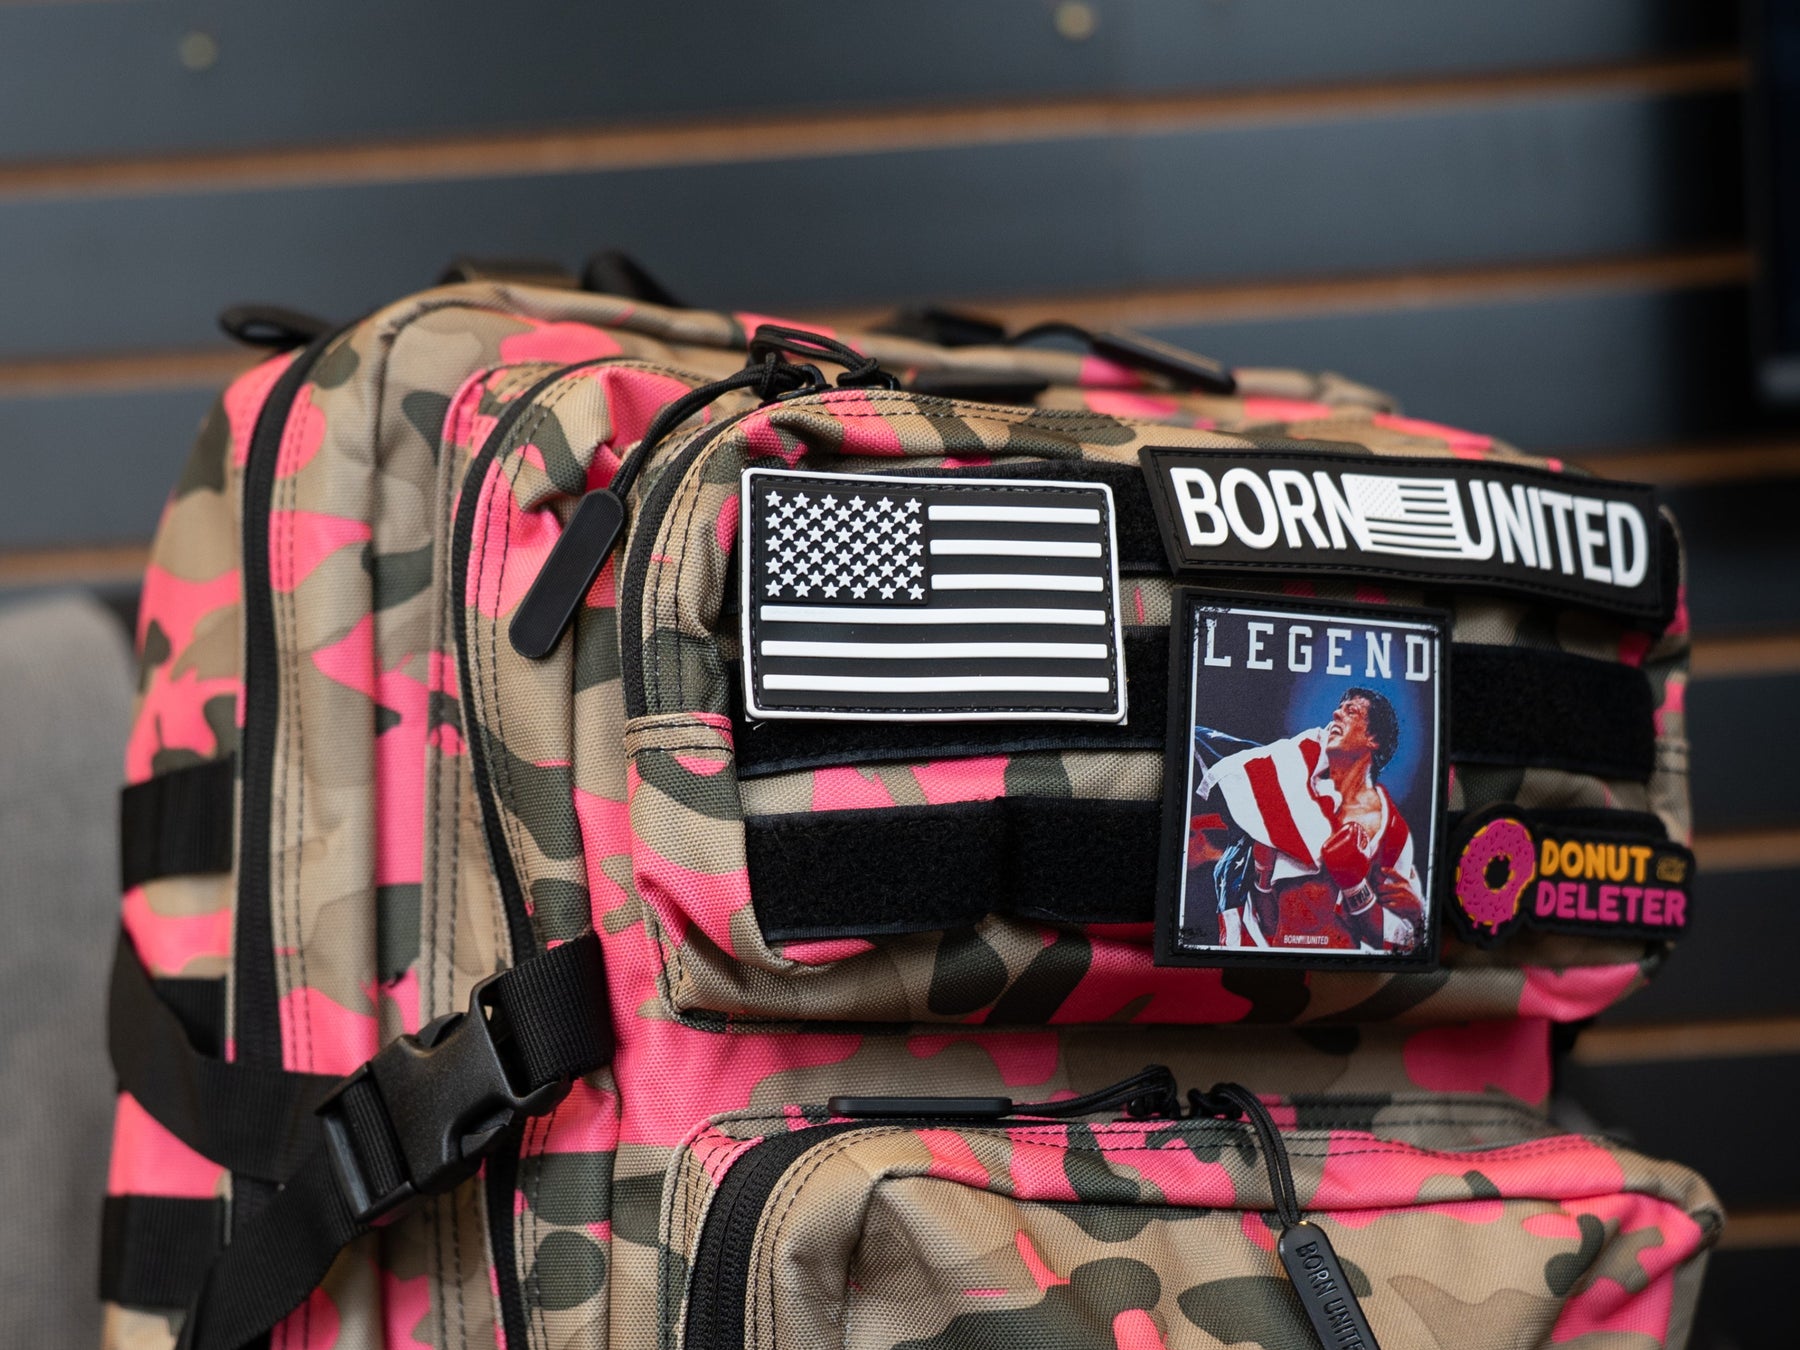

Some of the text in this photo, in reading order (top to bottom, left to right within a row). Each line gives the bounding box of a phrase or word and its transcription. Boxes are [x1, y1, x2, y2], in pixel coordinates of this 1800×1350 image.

[1170, 467, 1649, 588] BORN UNITED
[1204, 618, 1430, 682] LEGEND
[1539, 839, 1653, 883] DONUT
[1535, 880, 1687, 926] DELETER
[1283, 934, 1329, 945] BORN UNITED
[1295, 1241, 1338, 1299] BORN
